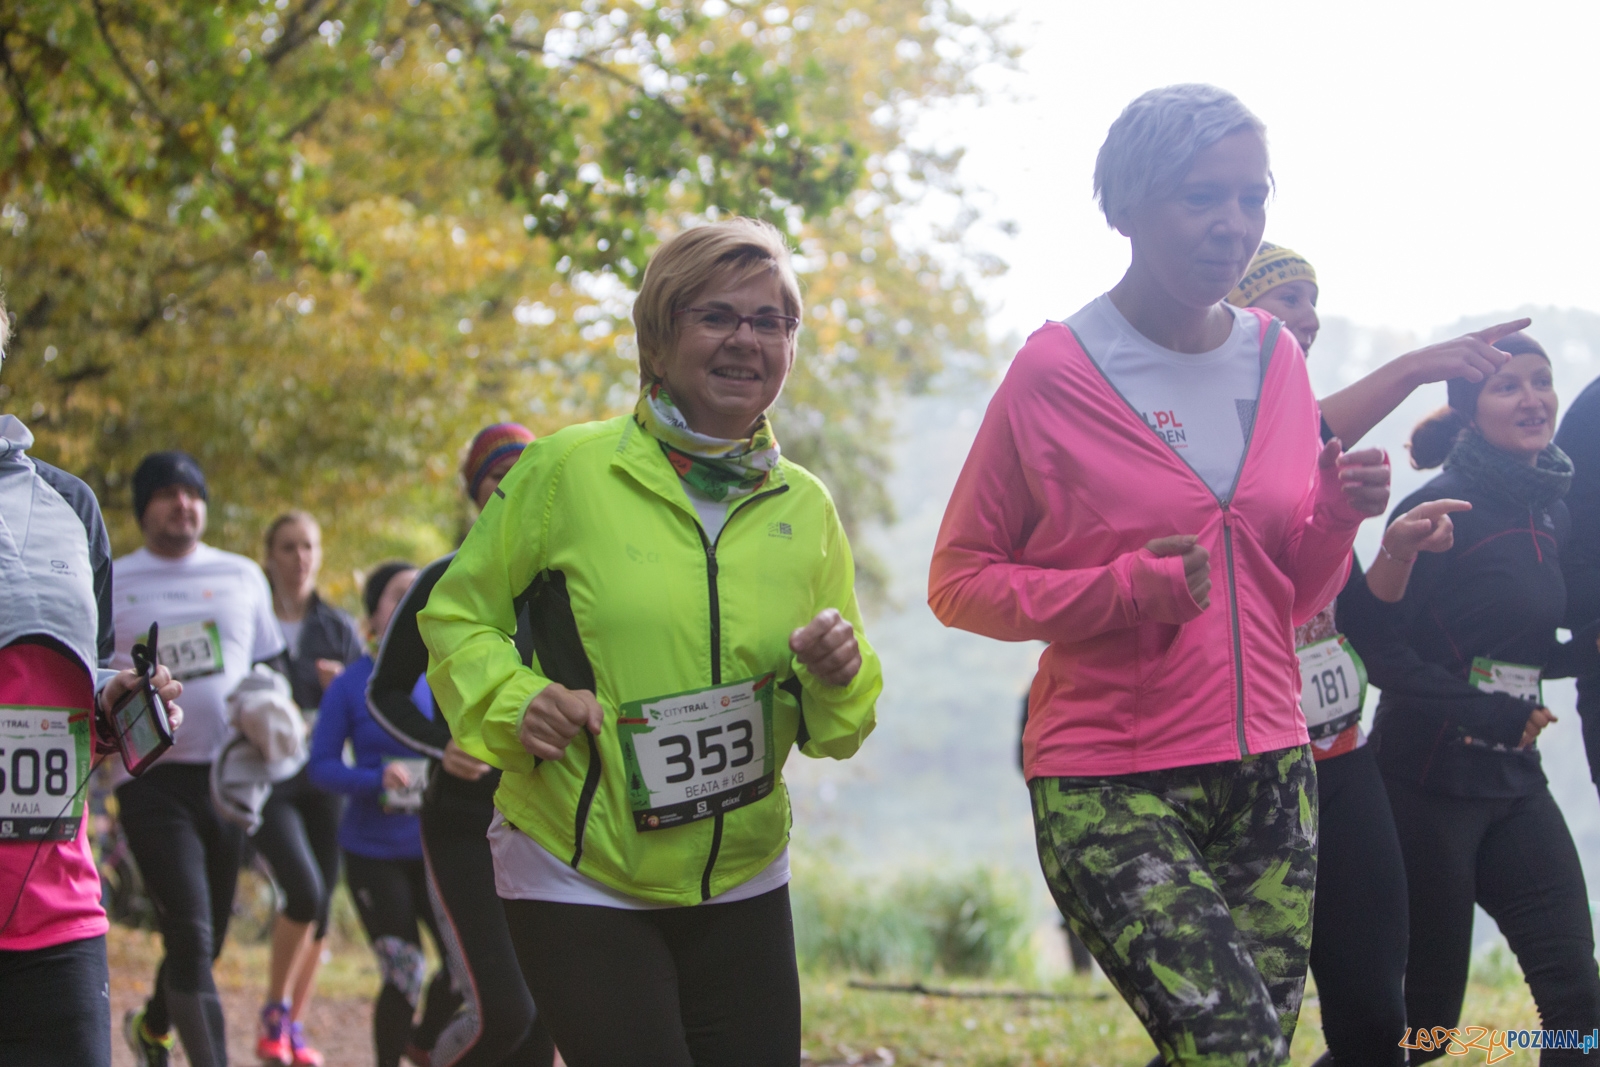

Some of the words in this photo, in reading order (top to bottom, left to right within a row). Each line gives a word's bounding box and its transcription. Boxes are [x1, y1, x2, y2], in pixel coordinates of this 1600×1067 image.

[1311, 665, 1349, 708] 181
[0, 748, 68, 796] 08
[658, 719, 754, 784] 353
[685, 781, 720, 798] BEATA
[722, 778, 730, 787] #
[732, 771, 744, 785] KB
[10, 802, 40, 814] MAJA
